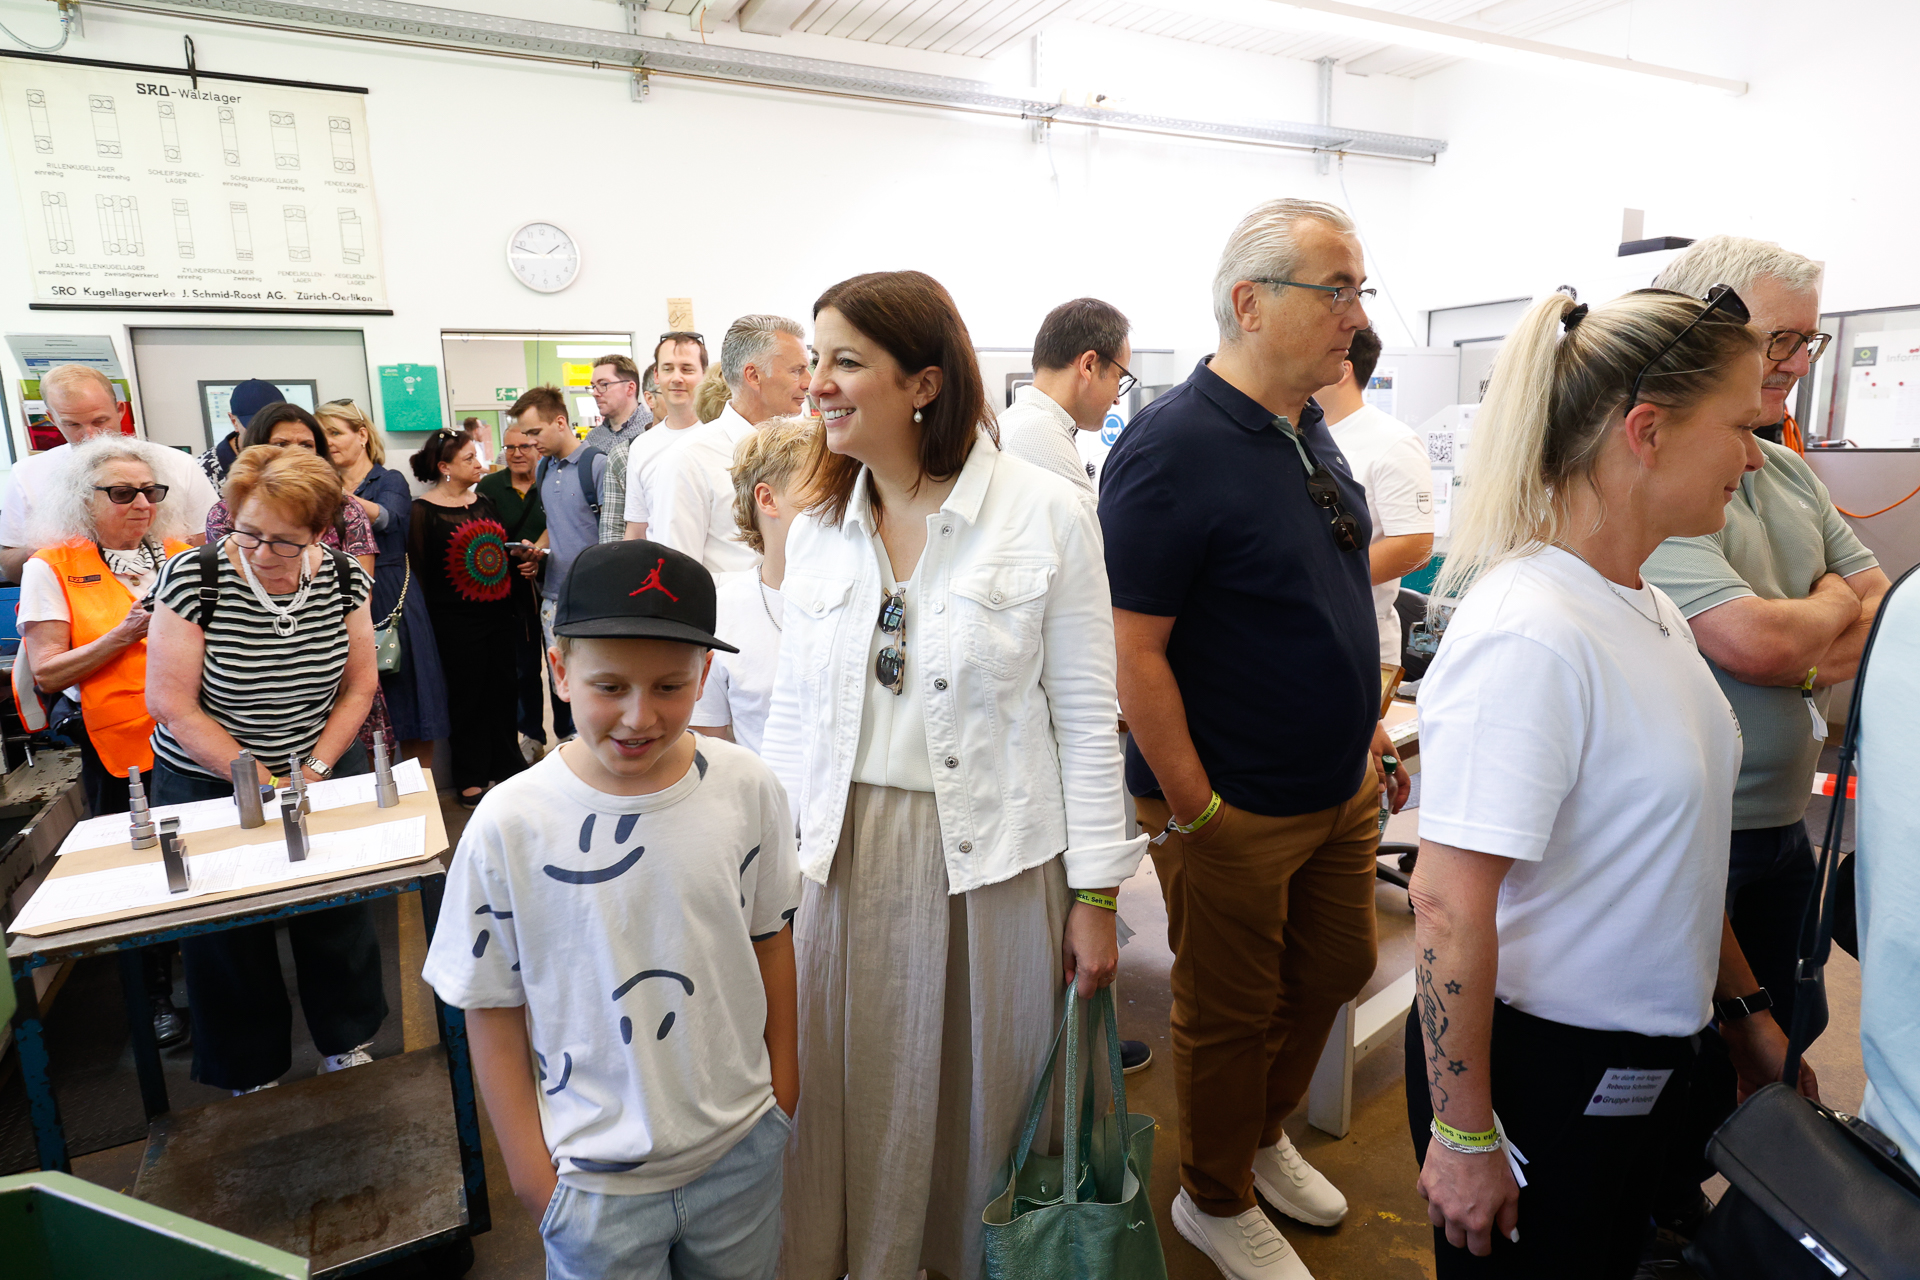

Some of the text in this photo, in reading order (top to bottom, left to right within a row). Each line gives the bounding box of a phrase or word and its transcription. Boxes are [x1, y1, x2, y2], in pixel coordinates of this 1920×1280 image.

[46, 162, 115, 172] RILLENKUGELLAGER
[34, 169, 131, 182] einreihig zweireihig
[164, 177, 188, 185] LAGER
[222, 180, 305, 193] einreihig zweireihig
[337, 187, 358, 195] LAGER
[182, 267, 254, 275] ZYLINDERROLLENLAGER
[51, 285, 77, 296] SRO
[83, 286, 176, 299] Kugellagerwerke
[192, 289, 262, 300] Schmid-Roost
[266, 291, 287, 300] AG.
[296, 291, 373, 302] Zürich-Oerlikon
[1091, 896, 1103, 905] Seit
[1602, 1095, 1631, 1105] Gruppe
[1440, 1124, 1454, 1137] Seit
[1456, 1133, 1481, 1142] rockt.
